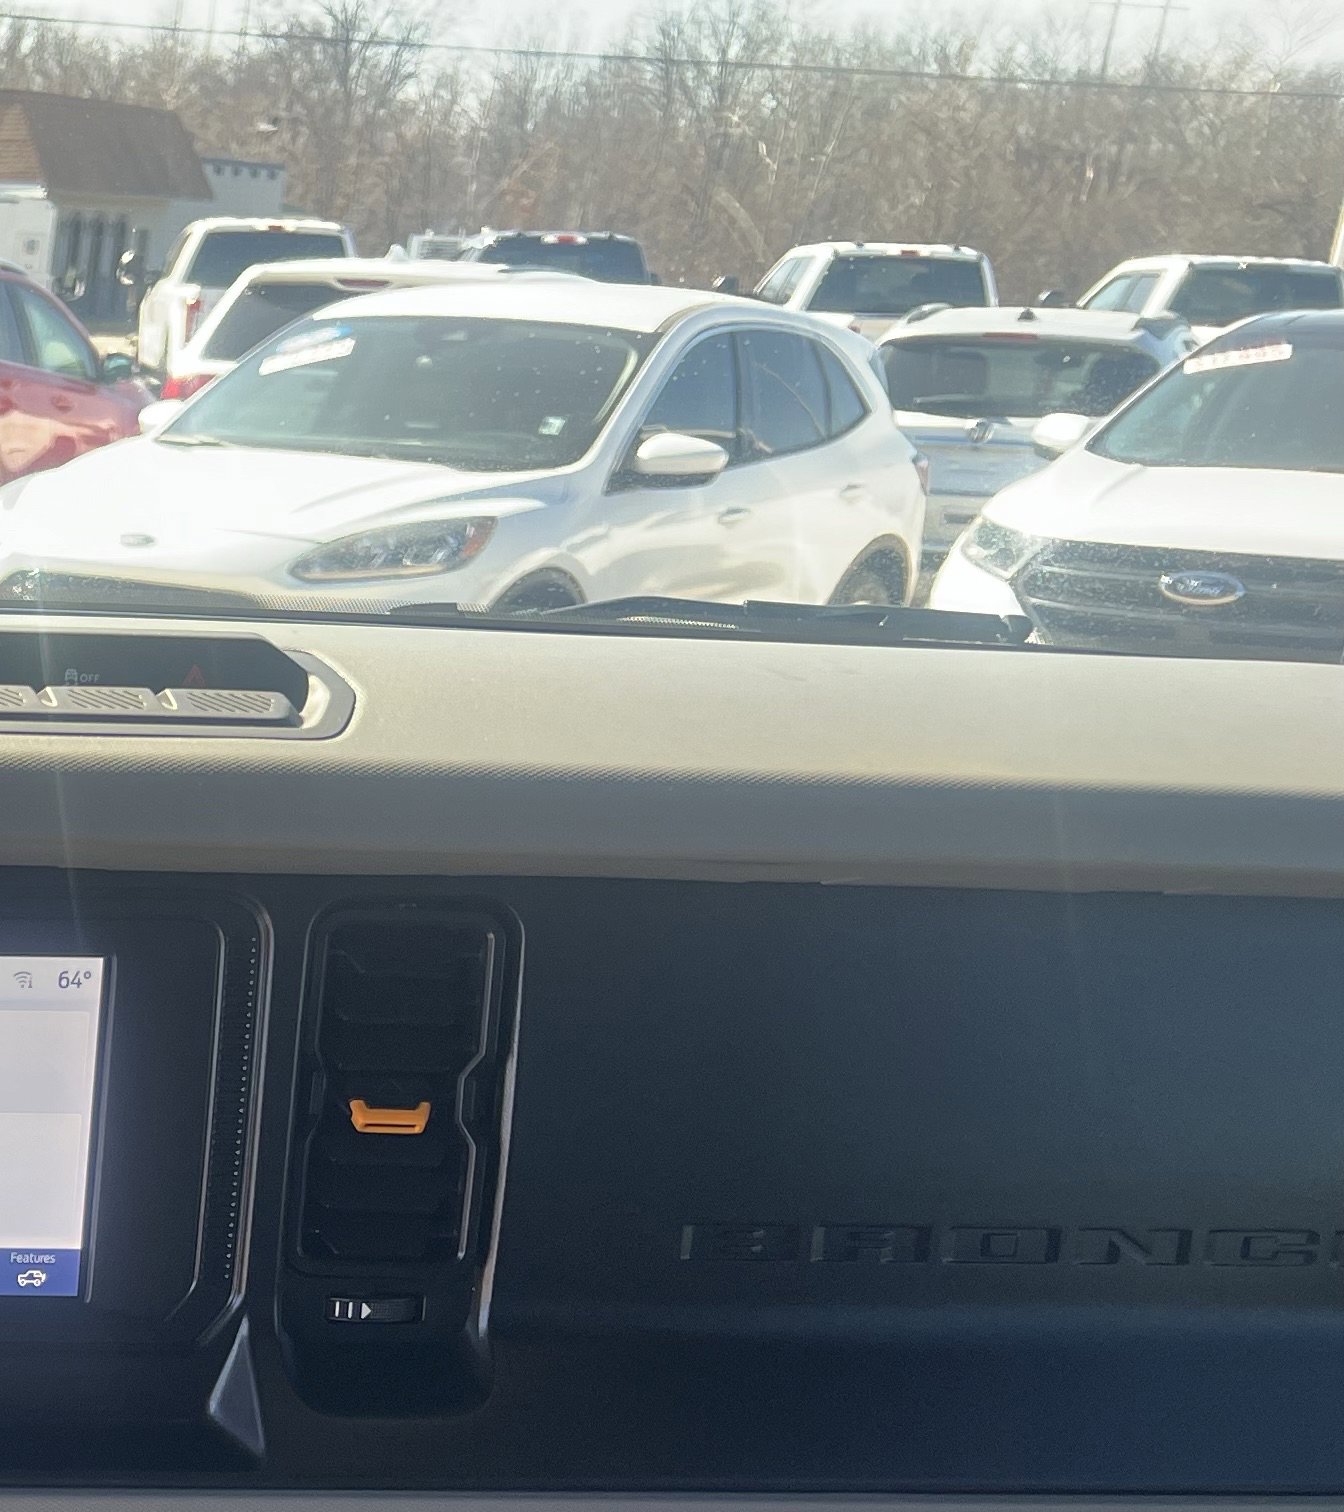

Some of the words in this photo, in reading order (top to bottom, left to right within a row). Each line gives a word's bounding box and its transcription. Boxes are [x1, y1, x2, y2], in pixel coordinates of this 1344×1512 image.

[79, 673, 100, 683] OFF
[57, 970, 92, 989] 64°
[679, 1222, 1344, 1268] BRONC
[10, 1251, 56, 1264] Features
